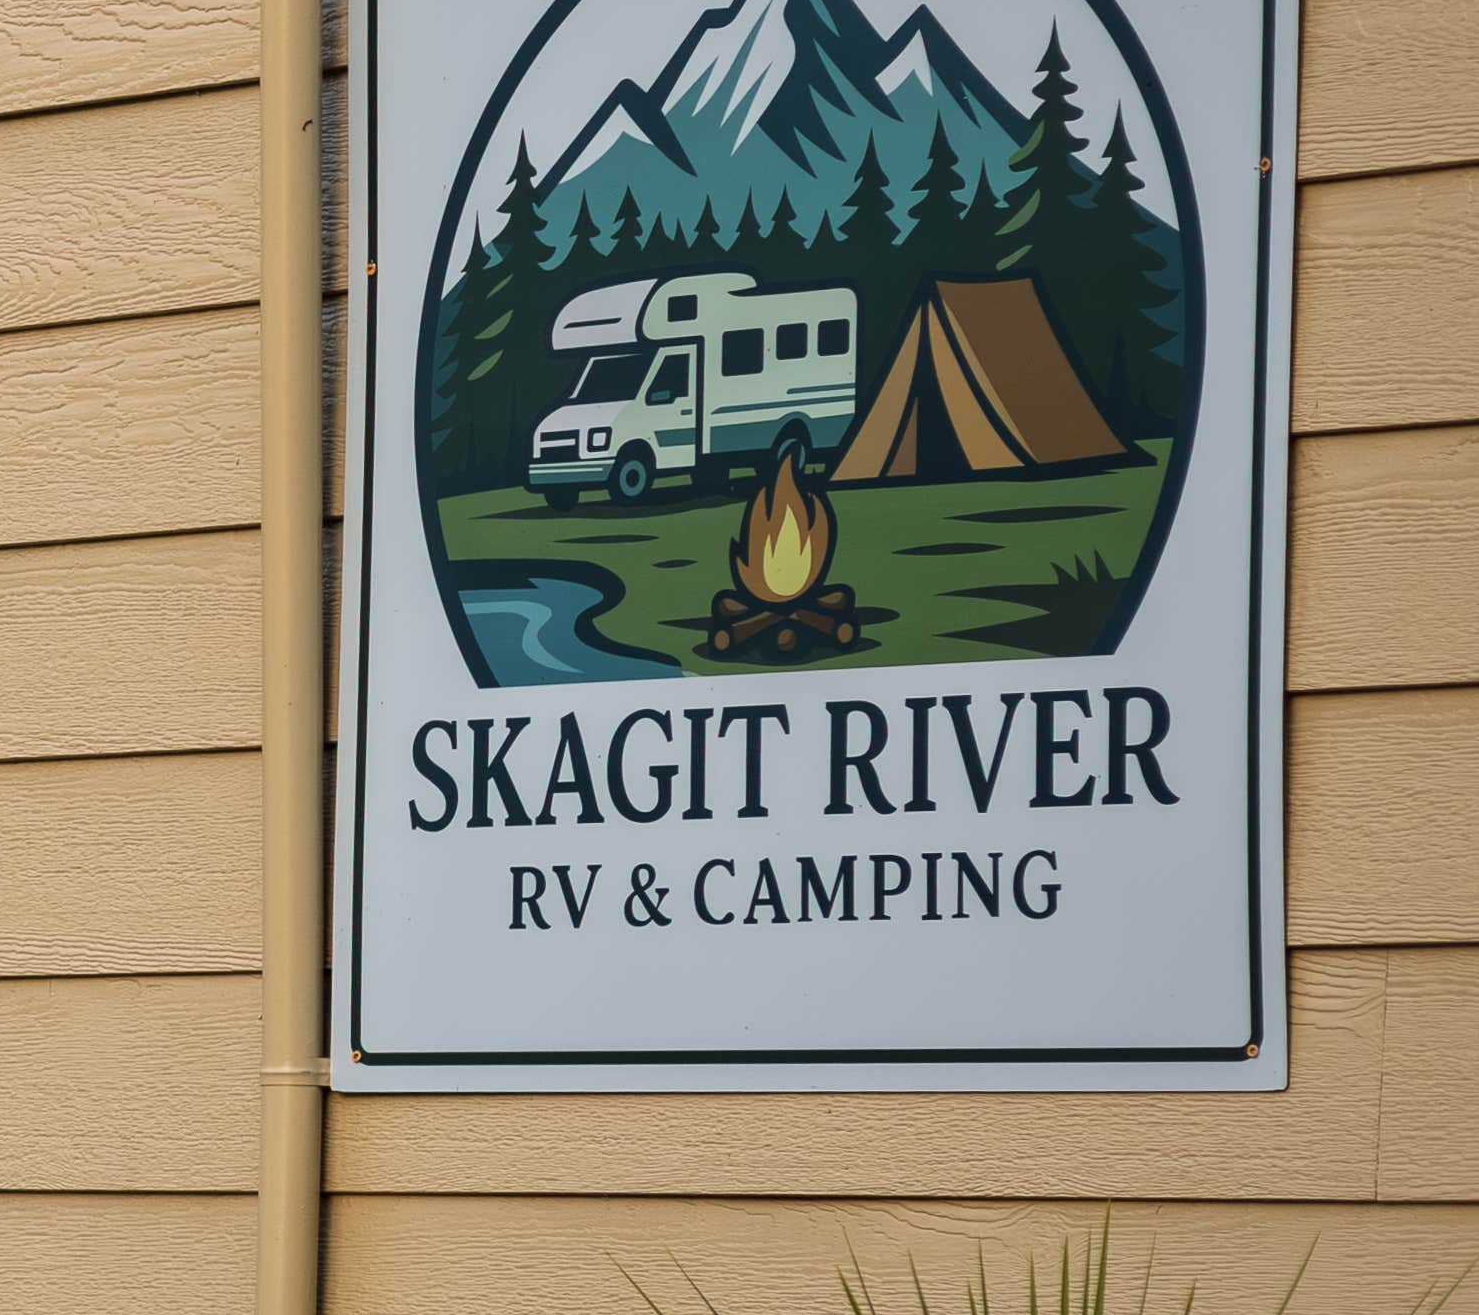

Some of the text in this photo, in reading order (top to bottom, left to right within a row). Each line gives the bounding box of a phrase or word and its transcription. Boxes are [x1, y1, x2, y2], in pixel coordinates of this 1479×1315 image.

[408, 686, 1181, 833] SKAGIT RIVER
[508, 849, 1063, 930] RV & CAMPING
